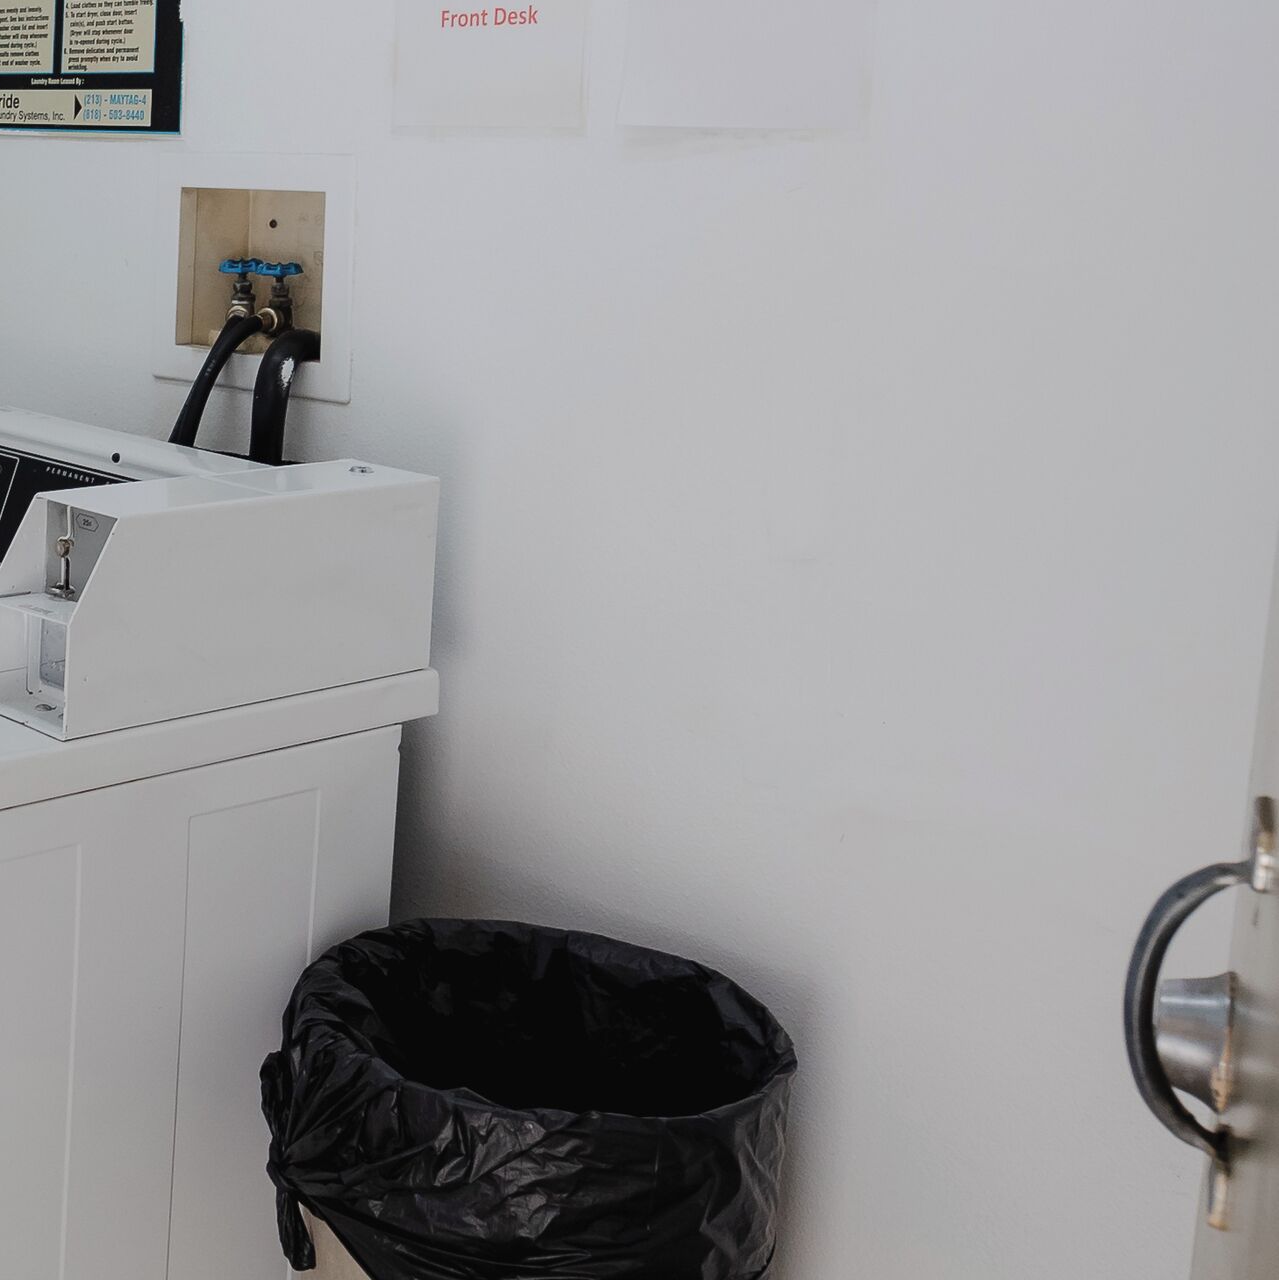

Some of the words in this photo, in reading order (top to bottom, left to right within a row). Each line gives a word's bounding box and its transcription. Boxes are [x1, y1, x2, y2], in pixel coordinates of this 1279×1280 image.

[440, 9, 488, 29] Front
[494, 6, 538, 27] Desk
[84, 95, 102, 106] (213)
[110, 94, 146, 105] MAYTAG-4
[19, 111, 50, 122] Systems,
[52, 112, 65, 120] Inc.
[46, 466, 95, 484] PERMANENT
